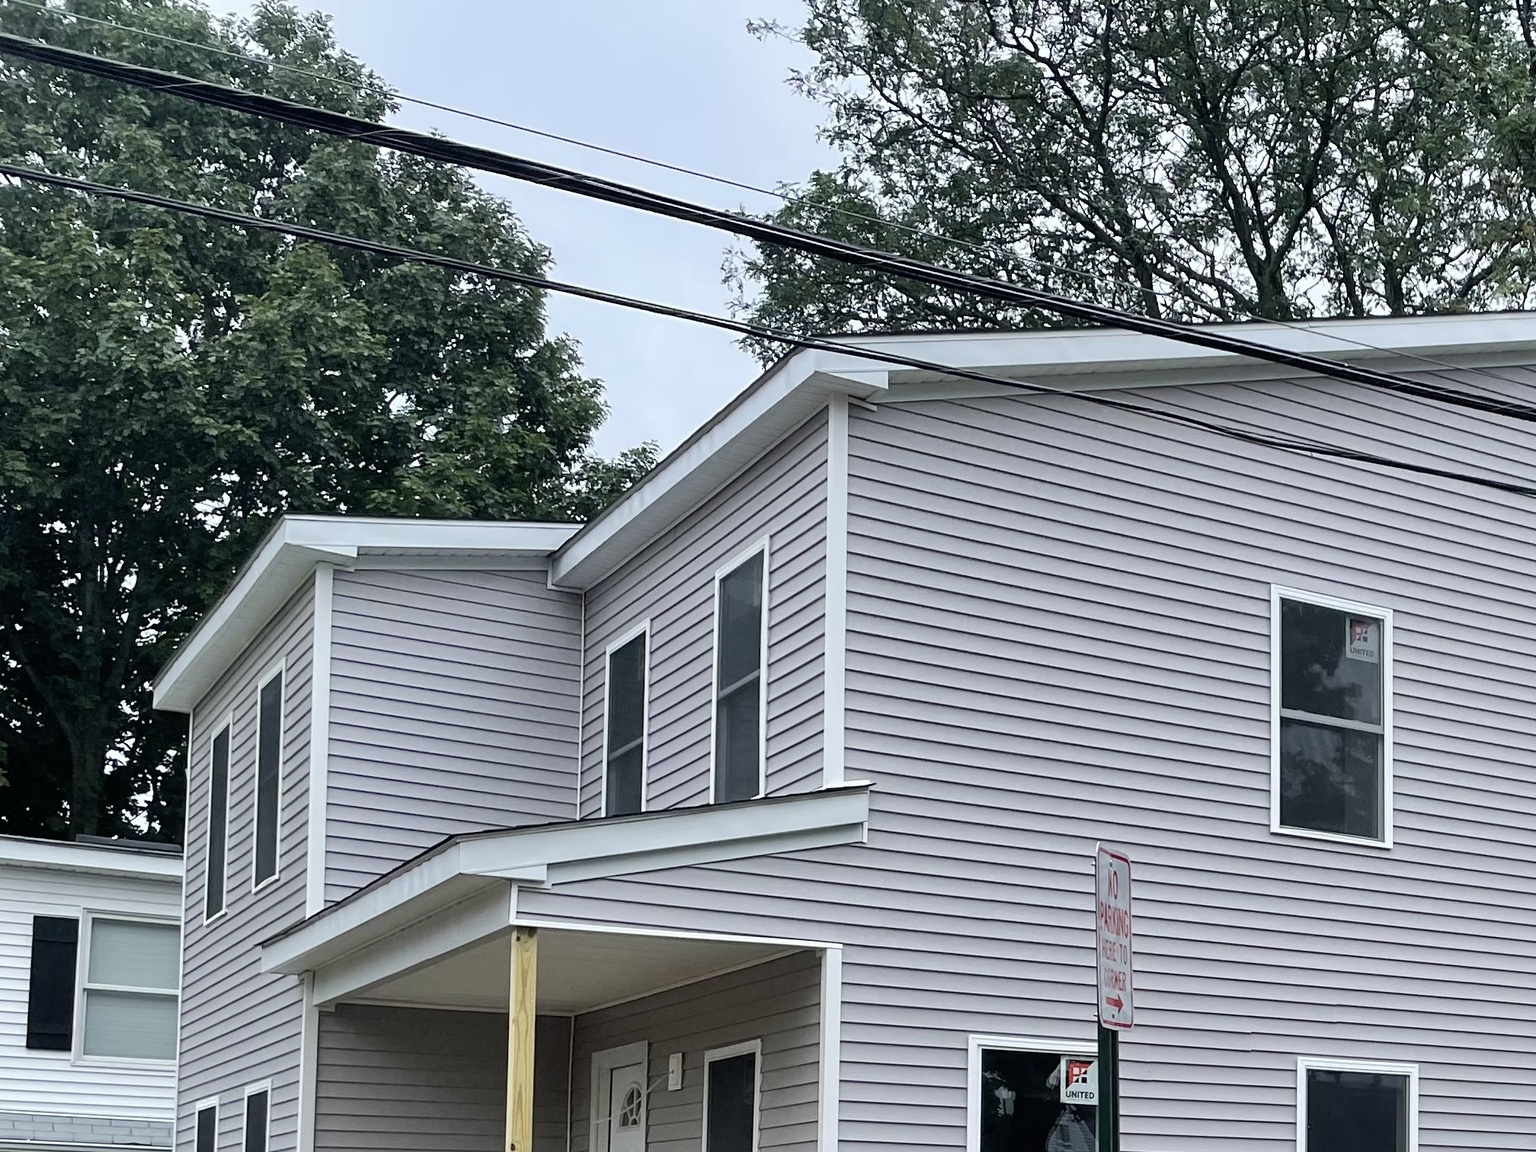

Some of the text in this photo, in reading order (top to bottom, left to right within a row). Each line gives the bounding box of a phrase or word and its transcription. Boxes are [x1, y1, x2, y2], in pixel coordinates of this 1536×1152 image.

[1108, 868, 1118, 899] NO
[1100, 901, 1129, 939] PARKING
[1102, 938, 1128, 965] HERE TO
[1104, 967, 1127, 992] CORNER
[1065, 1090, 1095, 1100] UNITED
